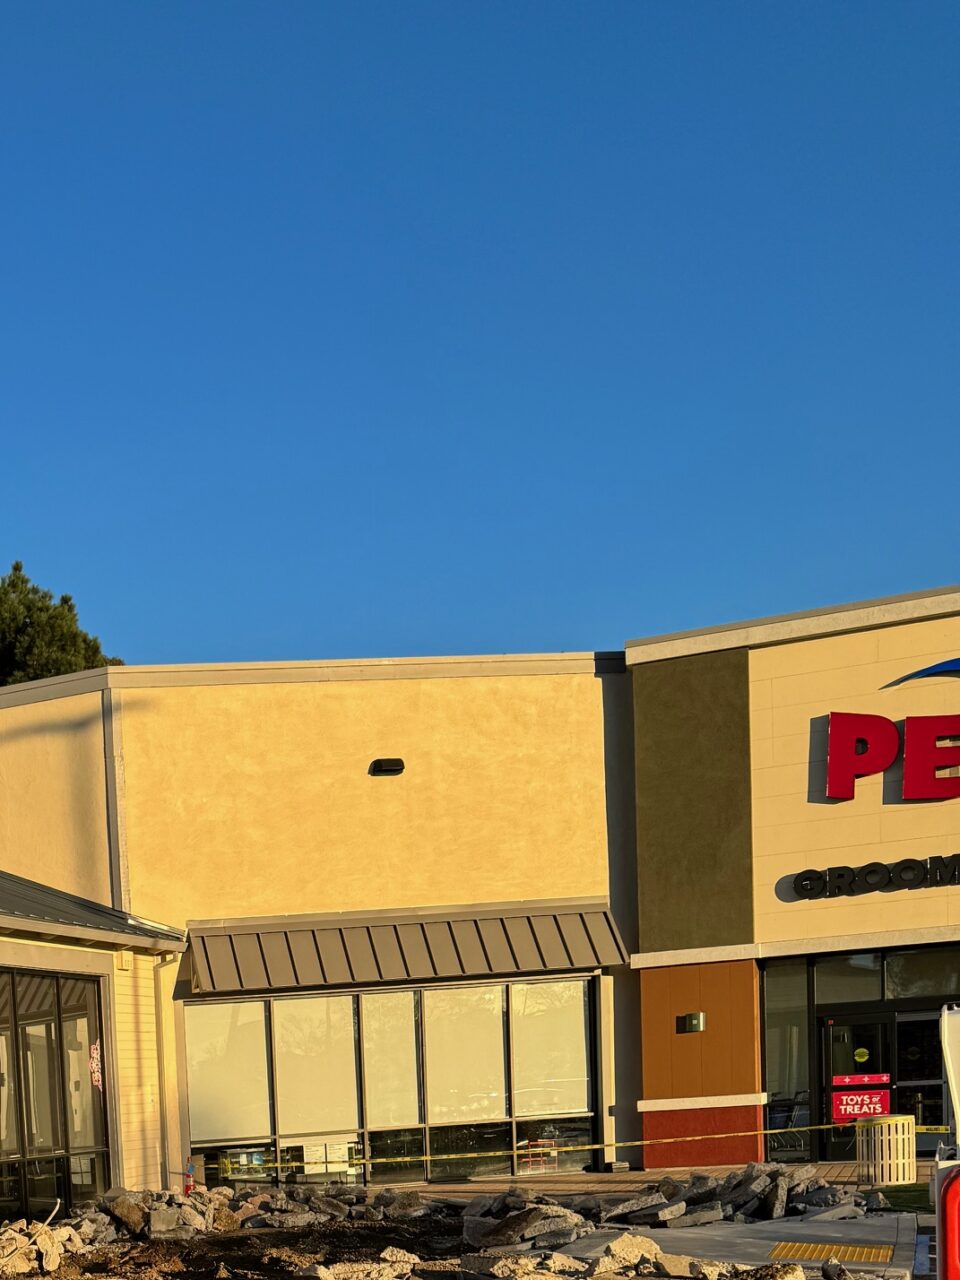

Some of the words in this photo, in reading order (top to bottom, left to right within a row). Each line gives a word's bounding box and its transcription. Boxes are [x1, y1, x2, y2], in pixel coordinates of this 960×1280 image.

[826, 712, 960, 800] PE
[793, 854, 960, 900] GROOM
[840, 1104, 882, 1114] TREATS
[841, 1095, 870, 1104] TOYS
